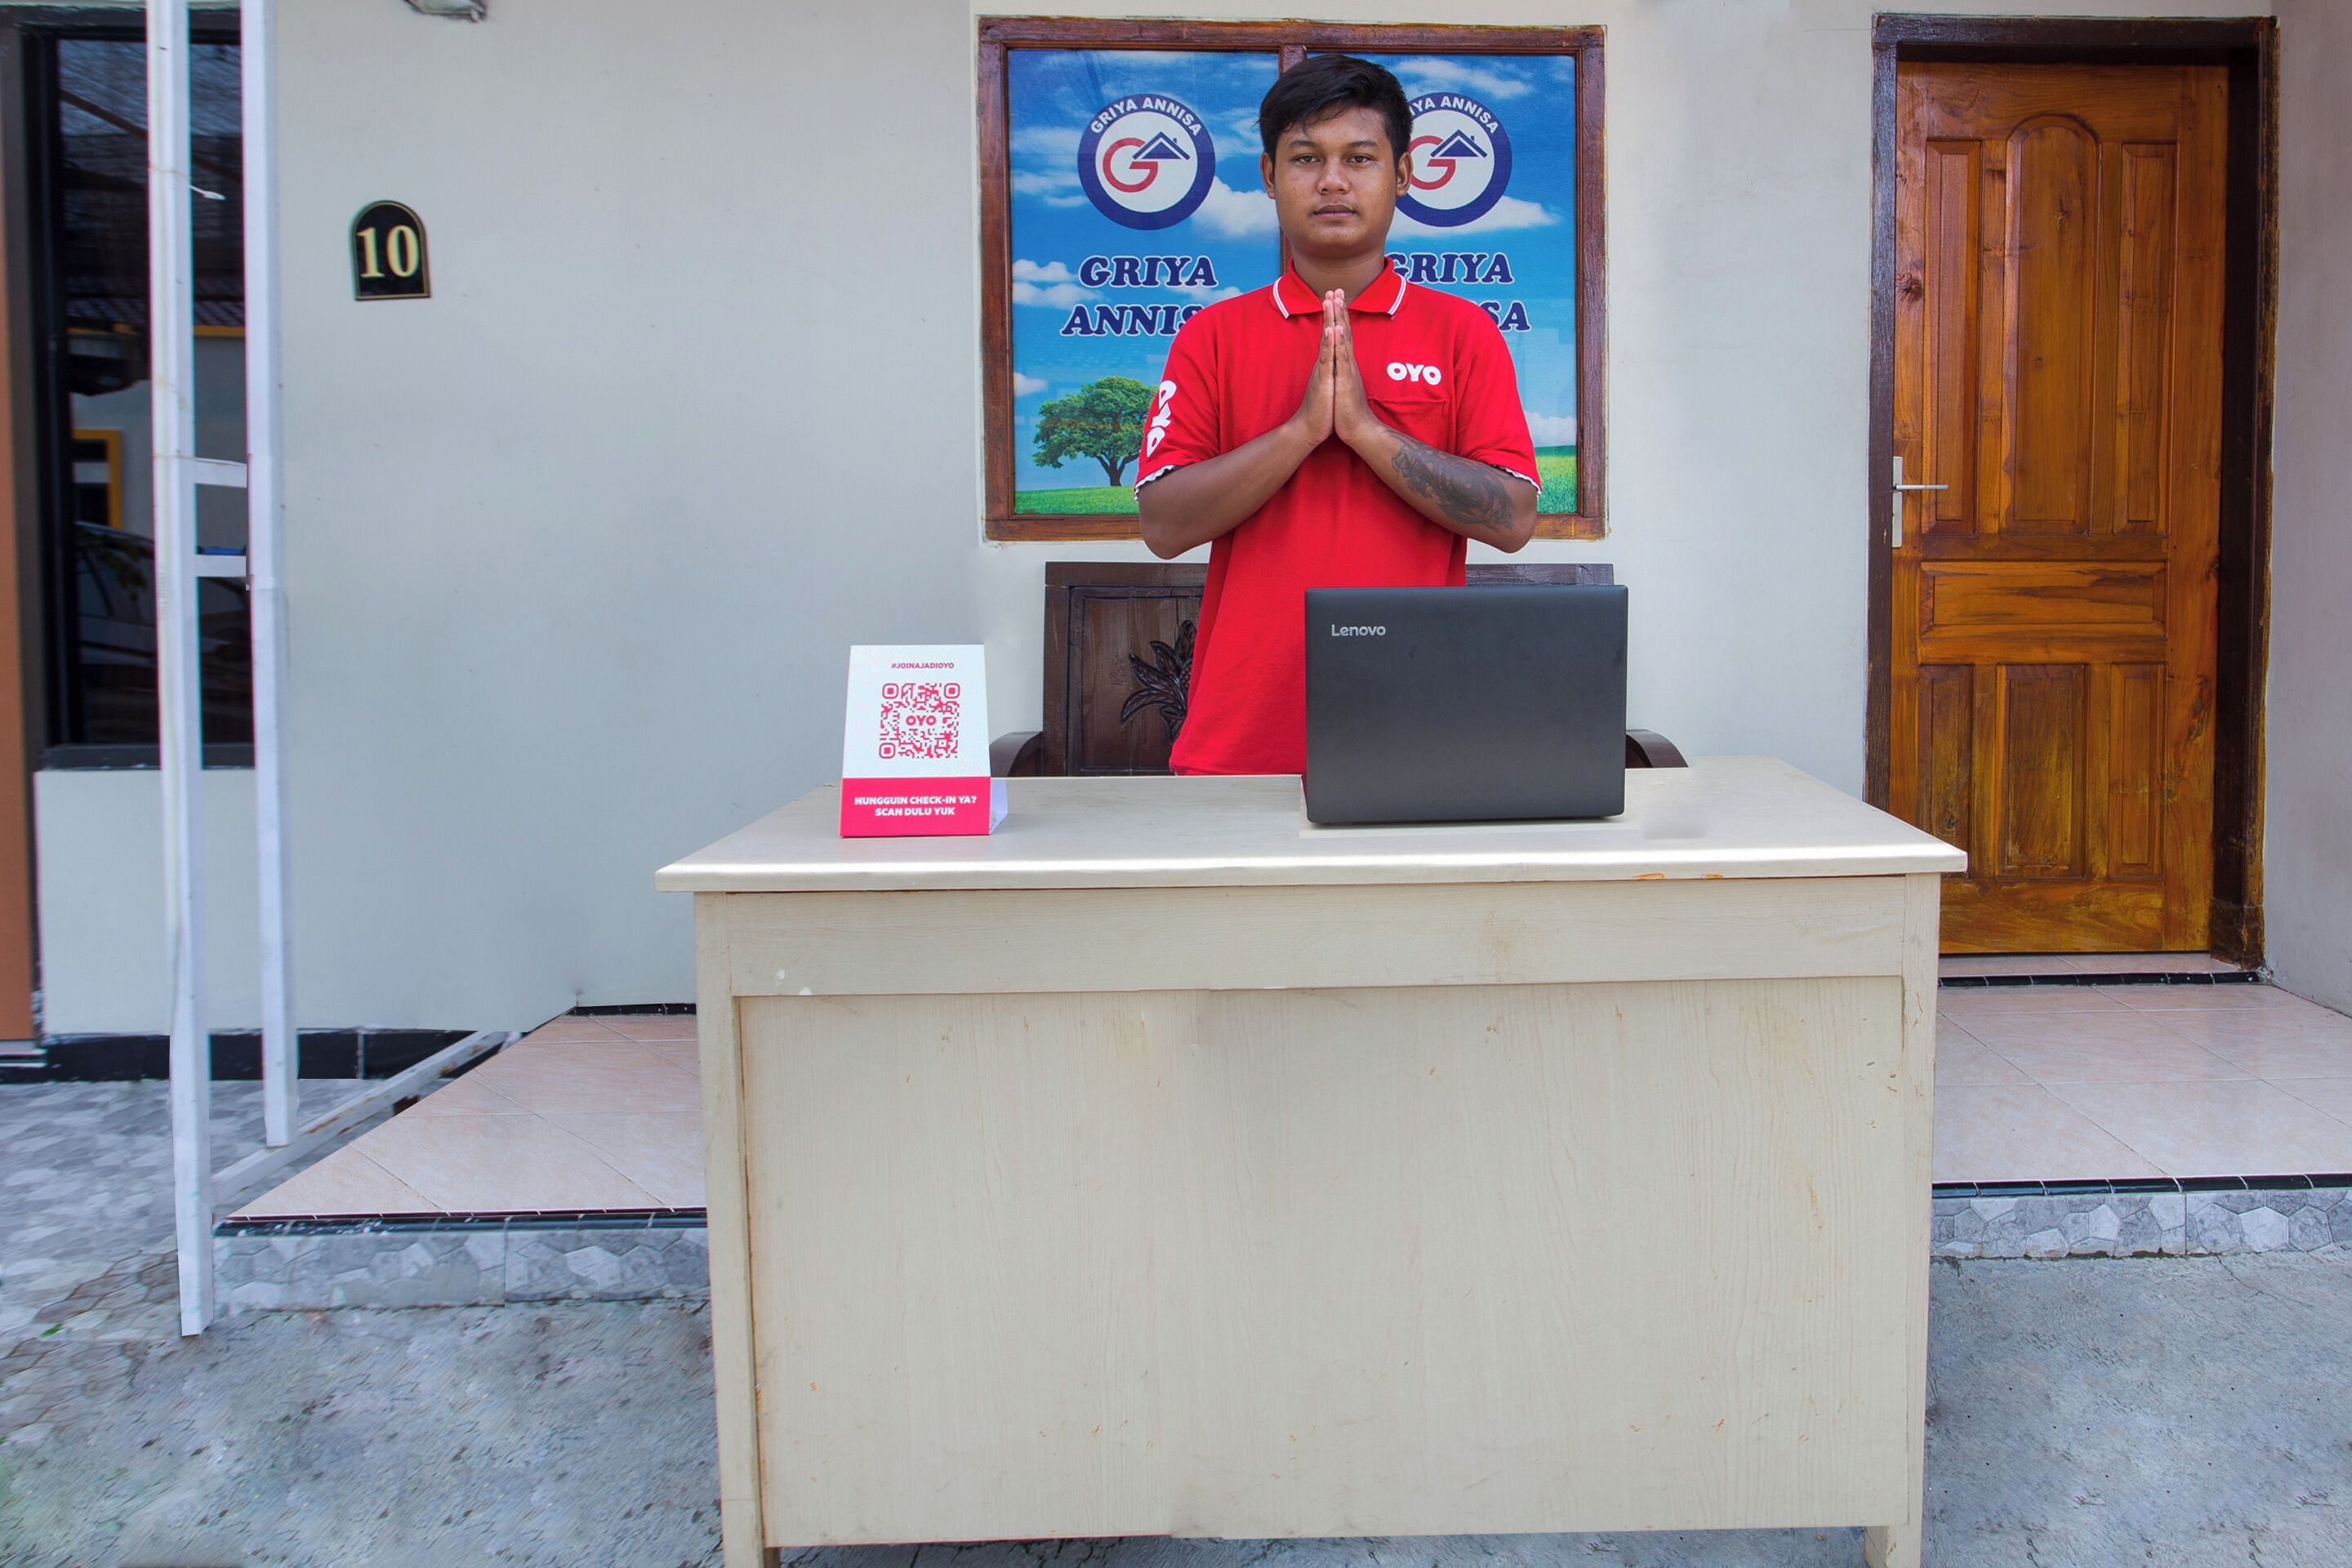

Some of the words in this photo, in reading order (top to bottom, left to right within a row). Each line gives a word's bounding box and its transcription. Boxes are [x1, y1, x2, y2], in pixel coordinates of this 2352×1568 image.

[1090, 99, 1138, 134] GRIYA
[1142, 97, 1202, 136] ANNISA
[1441, 96, 1499, 135] ANNISA
[356, 225, 420, 278] 10
[1079, 255, 1218, 287] GRIYA
[1387, 362, 1441, 385] OYO
[1147, 380, 1177, 458] OYO
[1331, 624, 1386, 636] Lenovo
[905, 715, 937, 726] OYO
[854, 796, 907, 804] NUNGGUIN
[910, 796, 956, 804] CHECK-IN
[959, 795, 977, 804] YA?
[875, 808, 902, 816] SCAN
[904, 808, 931, 816] DULU
[933, 807, 955, 815] YUK
